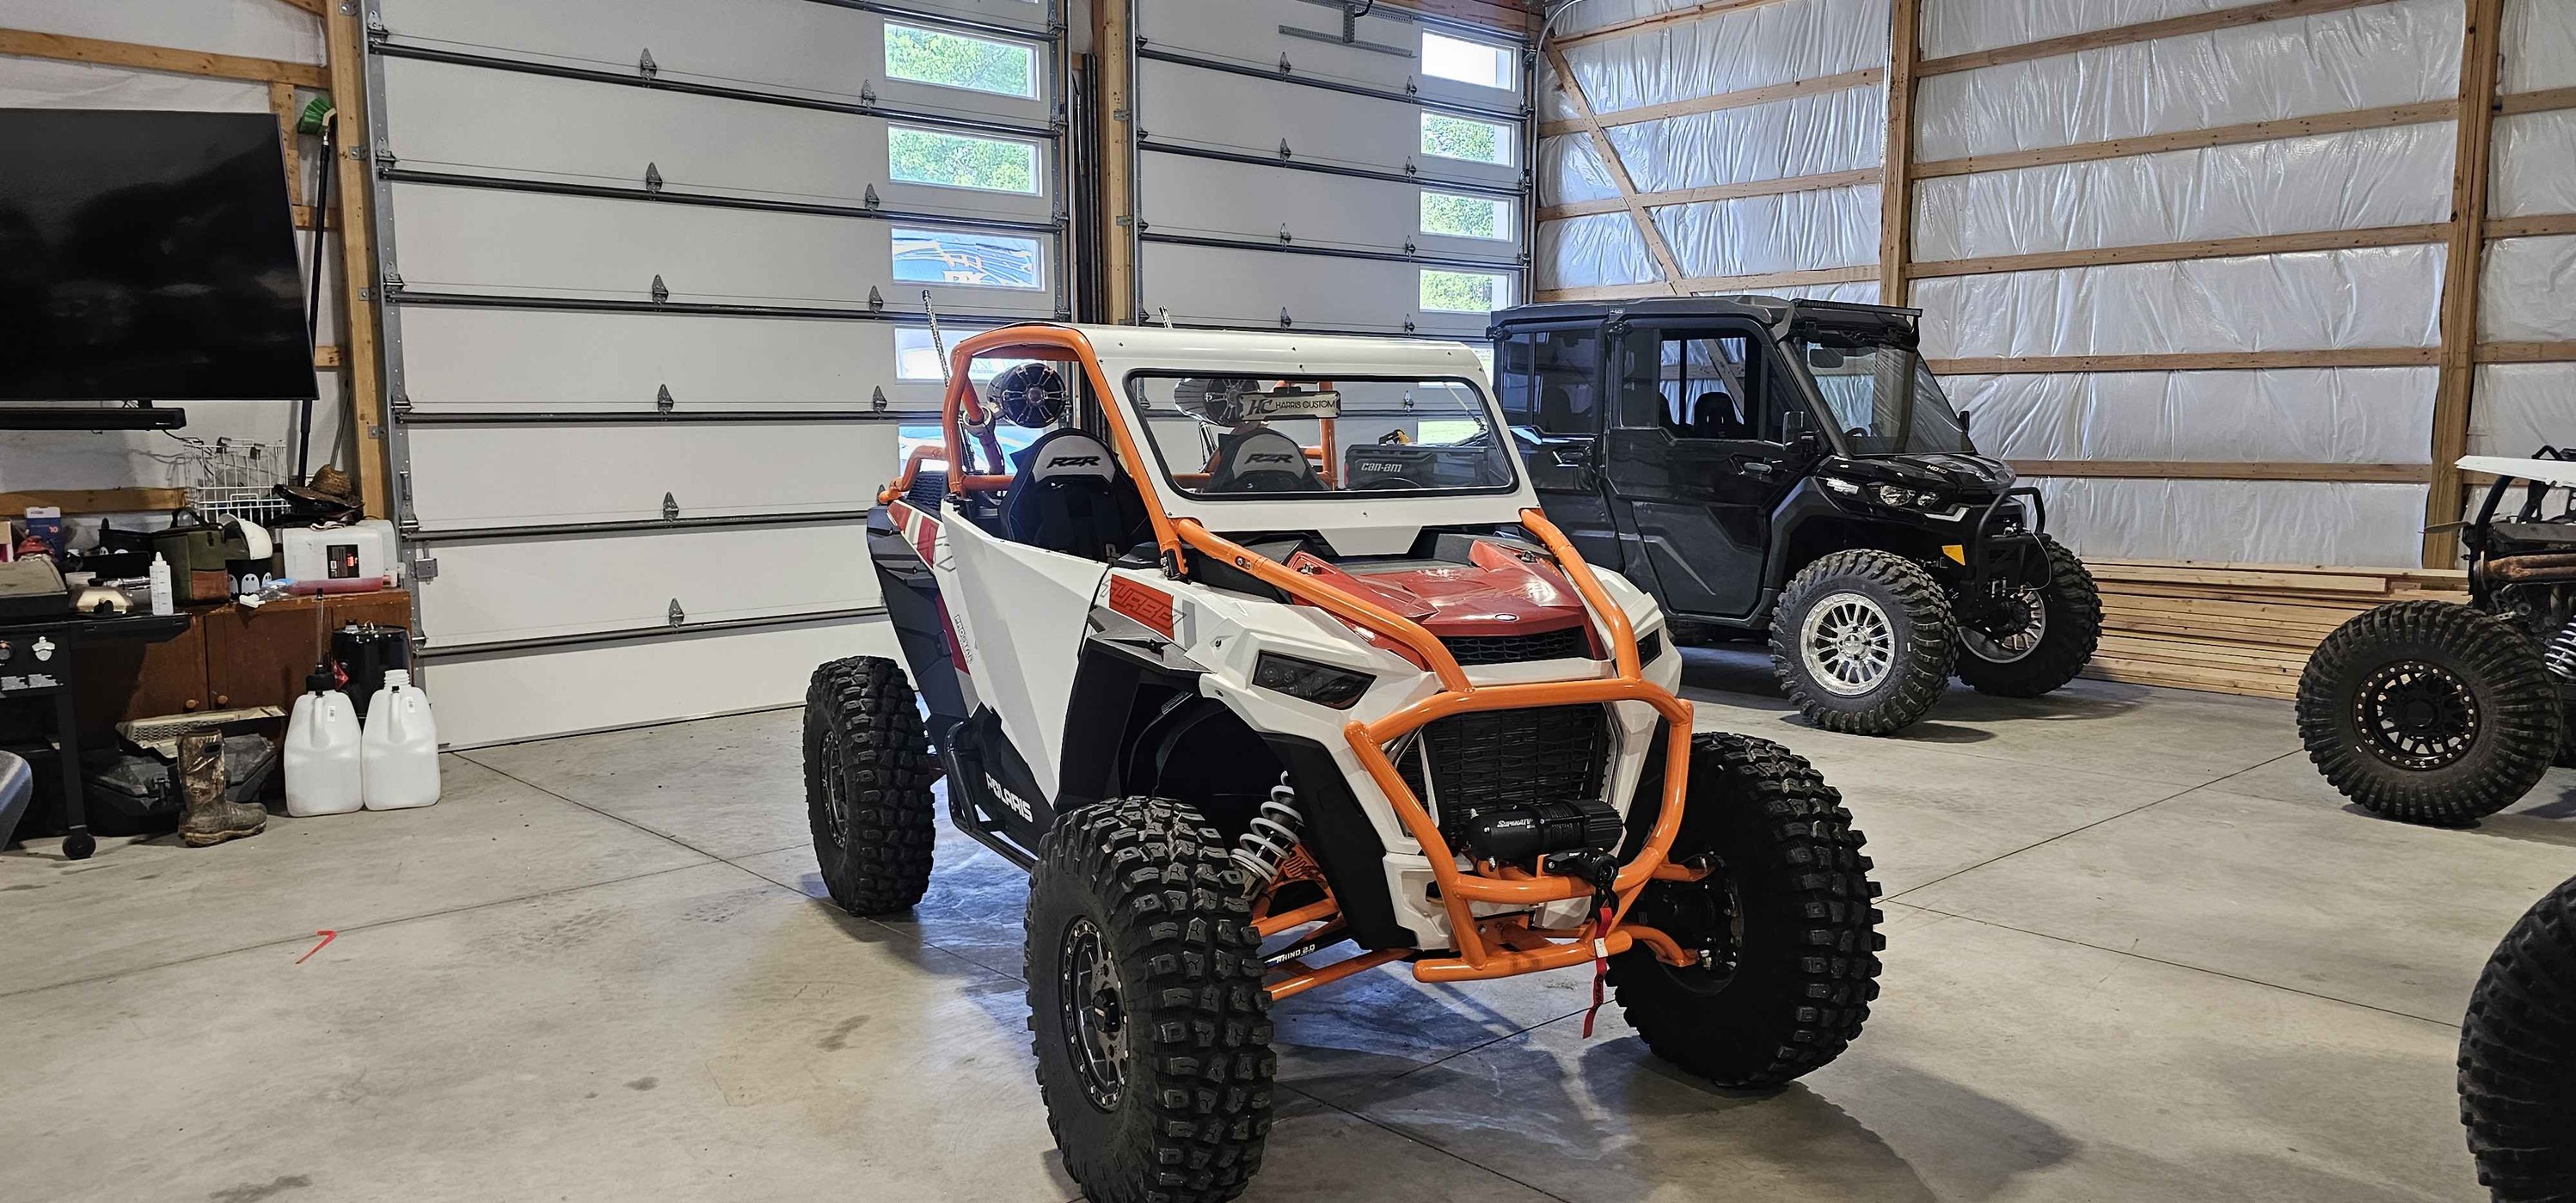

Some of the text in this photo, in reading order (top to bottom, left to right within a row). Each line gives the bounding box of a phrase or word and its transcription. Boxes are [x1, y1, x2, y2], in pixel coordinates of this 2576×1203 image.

[1275, 399, 1335, 409] HARRIS CUSTOM
[1046, 455, 1101, 470] RZR
[1244, 452, 1294, 465] RZR
[1100, 579, 1187, 630] TURBO
[984, 770, 1033, 823] POLARIS
